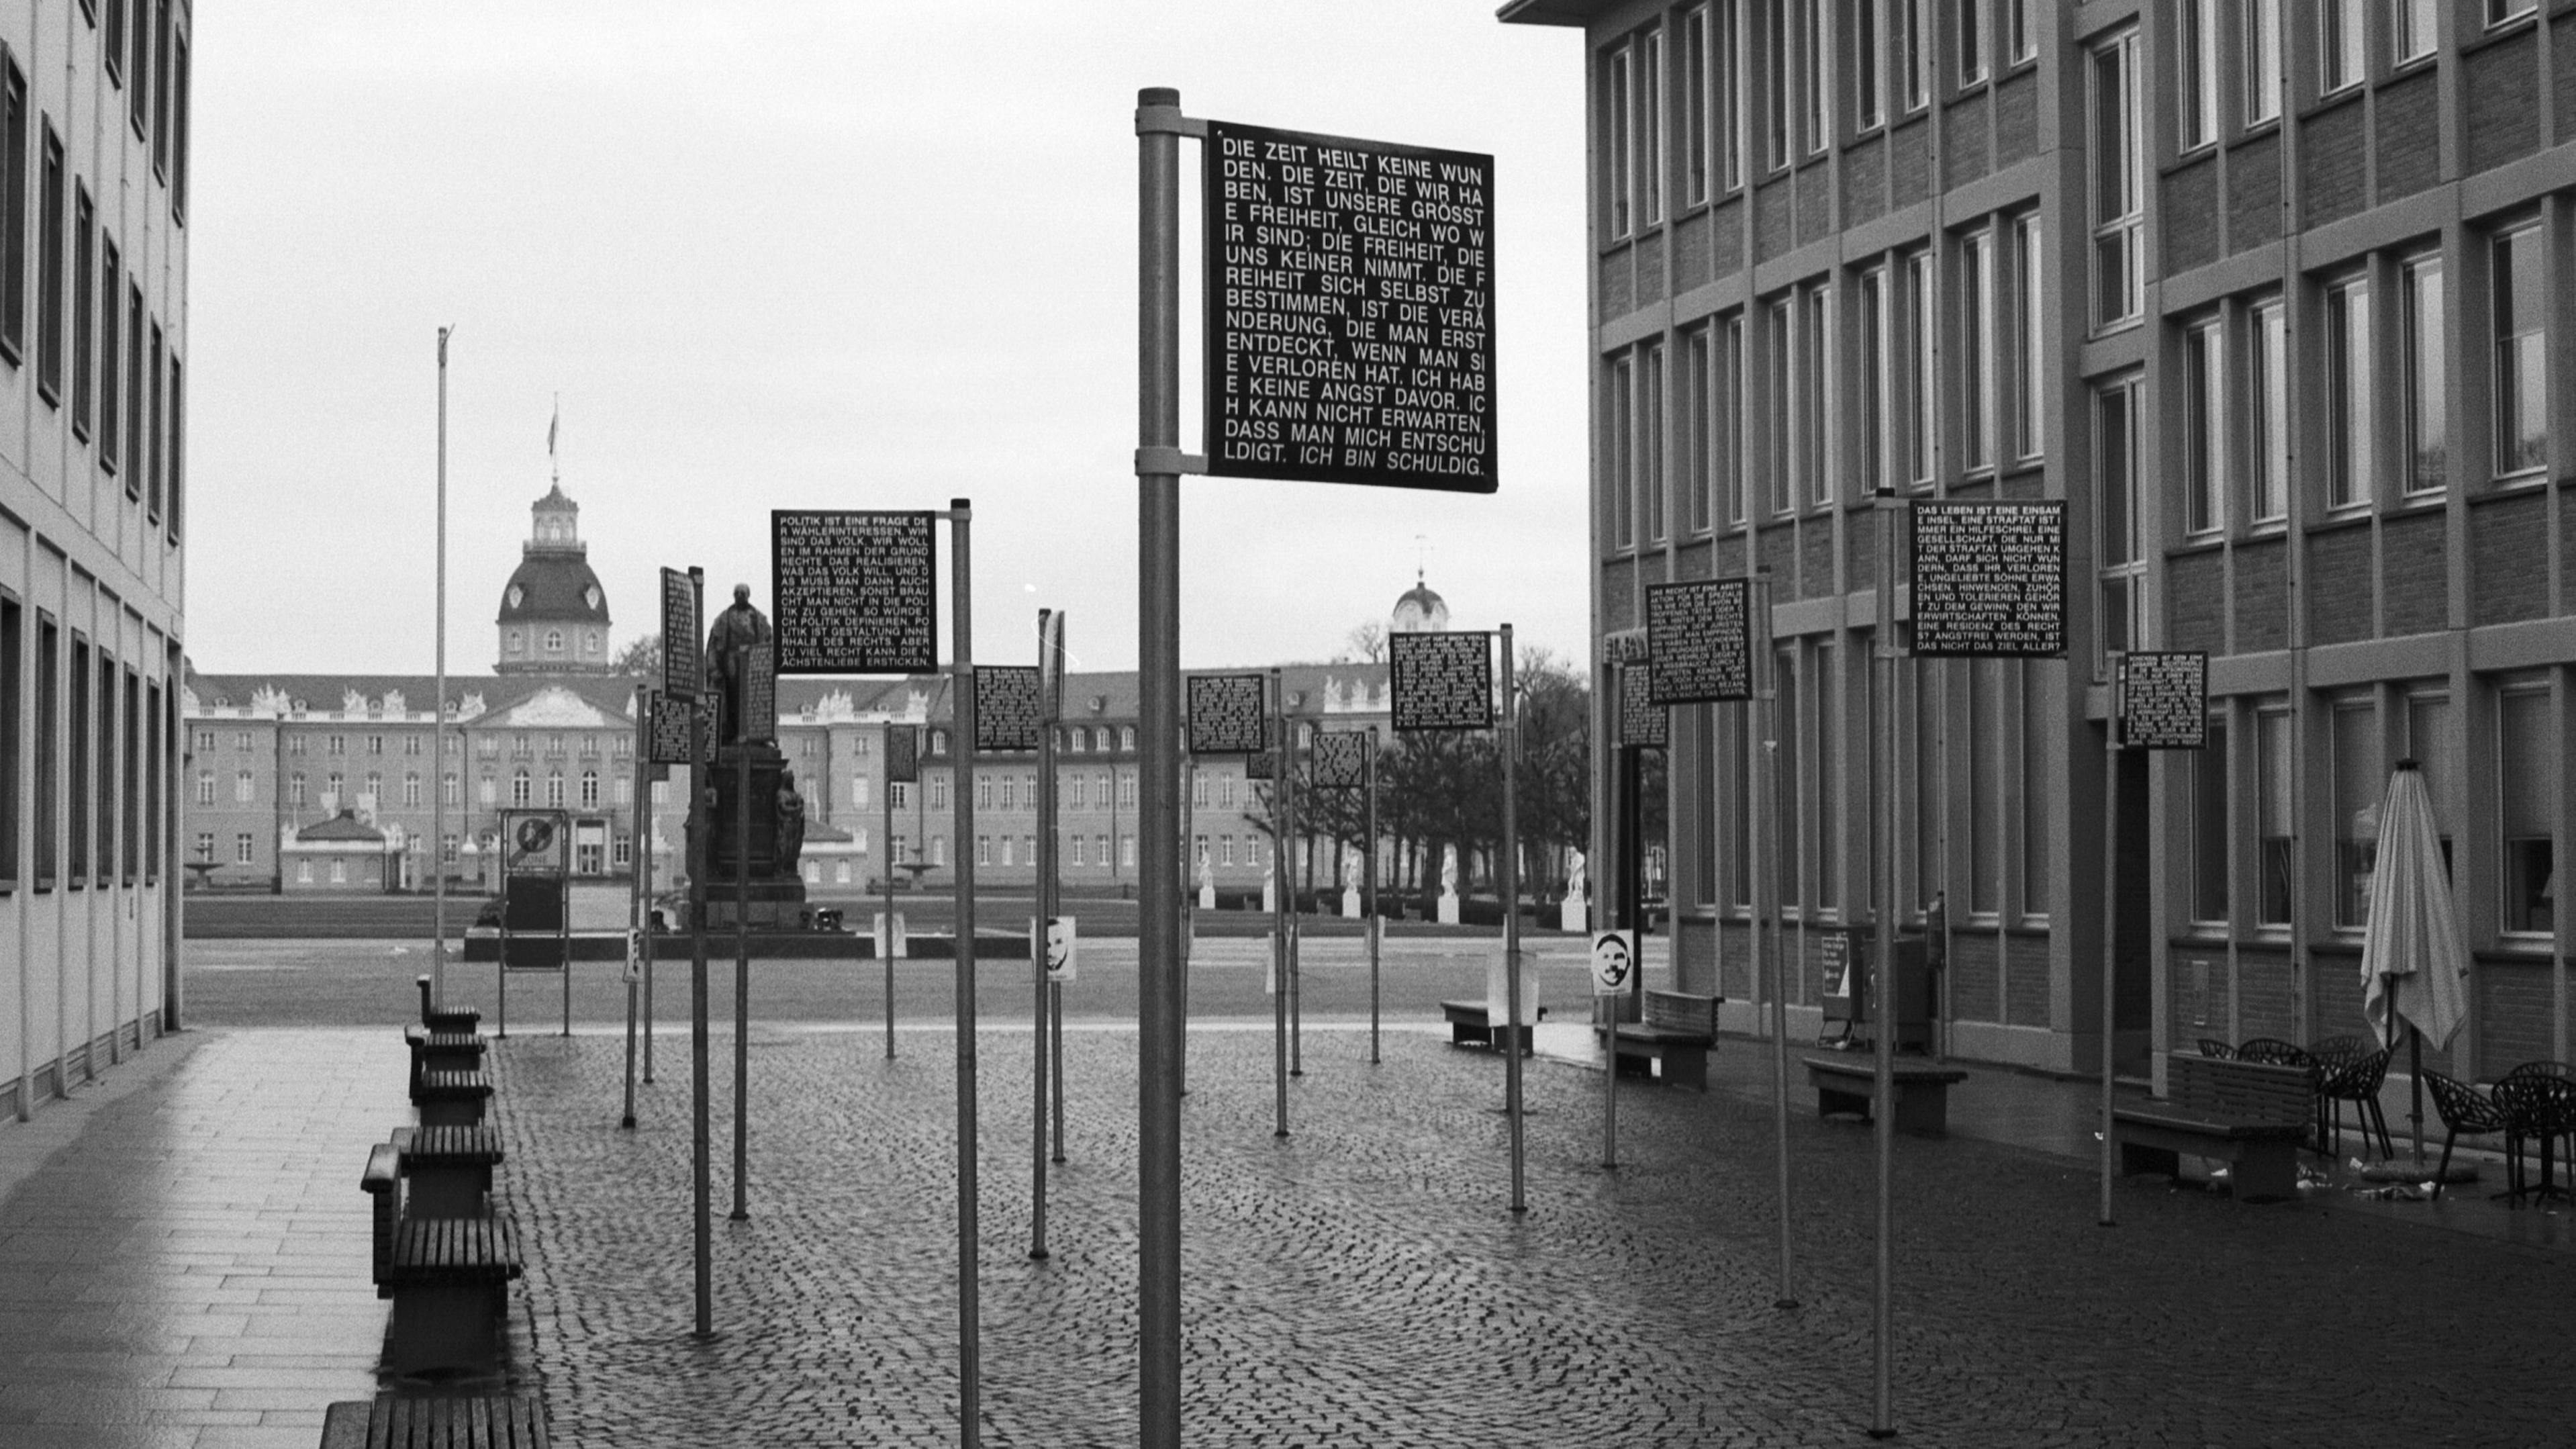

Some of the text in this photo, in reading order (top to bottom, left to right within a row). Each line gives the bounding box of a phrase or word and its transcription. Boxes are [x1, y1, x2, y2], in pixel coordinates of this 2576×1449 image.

[1223, 138, 1481, 185] DIE ZEIT HEILT KEINE WUN
[1225, 160, 1483, 205] DEN. DIE ZEIT, DIE WIR HA
[1225, 181, 1484, 226] BEN, IST UNSERE GRÖSST
[1225, 202, 1484, 247] E FREIHEIT, GLEICH WO W
[1226, 224, 1484, 267] IR SIND; DIE FREIHEIT, DIE
[1226, 245, 1485, 287] UNS KEINER NIMMT. DIE F
[1226, 267, 1484, 309] REIHEIT SICH SELBST ZU
[1227, 289, 1485, 330] BESTIMMEN, IST DIE VERÄ
[1227, 310, 1485, 350] NDERUNG, DIE MAN ERST
[1227, 332, 1485, 371] ENTDECKT, WENN MAN SI
[1227, 353, 1485, 391] E VERLOREN HAT. ICH HAB
[1227, 375, 1485, 412] E KEINE ANGST DAVOR. IC
[1226, 398, 1484, 434] H KANN NICHT ERWARTEN,
[1226, 419, 1485, 455] DASS MAN MICH ENTSCHU
[1225, 440, 1484, 475] LDIGT. ICH BIN SCHULDIG.
[780, 516, 927, 526] POLITIK IST EINE FRAGE DE
[1917, 506, 2060, 515] DAS LEBEN IST EINE EINSAM
[1962, 515, 2054, 524] EINE STRAFTAT IST
[1917, 524, 2060, 534] MMER EIN HILFESCHREI. EINE
[781, 536, 928, 546] SIND DAS WIR WOLL
[781, 546, 928, 556] EN IM RAHMEN DER GRUND
[1927, 543, 2050, 553] DER STRAFTAT UMGEHEN
[1946, 553, 2060, 563] DARF SICH NICHT WUN
[781, 576, 928, 586] AS MUSS MAN DANN AUCH
[781, 596, 929, 606] CHT MAN NICHT IN DIE POLI
[1917, 592, 2060, 602] EN UND TOLERIEREN GEHÖR
[782, 626, 928, 637] LITIK IST GESTALTUNG INNE
[1917, 620, 2060, 630] EINE RESIDENZ DES RECHT
[827, 647, 896, 657] RECHT KANN
[1917, 641, 2017, 650] DAS NICHT ZIEL
